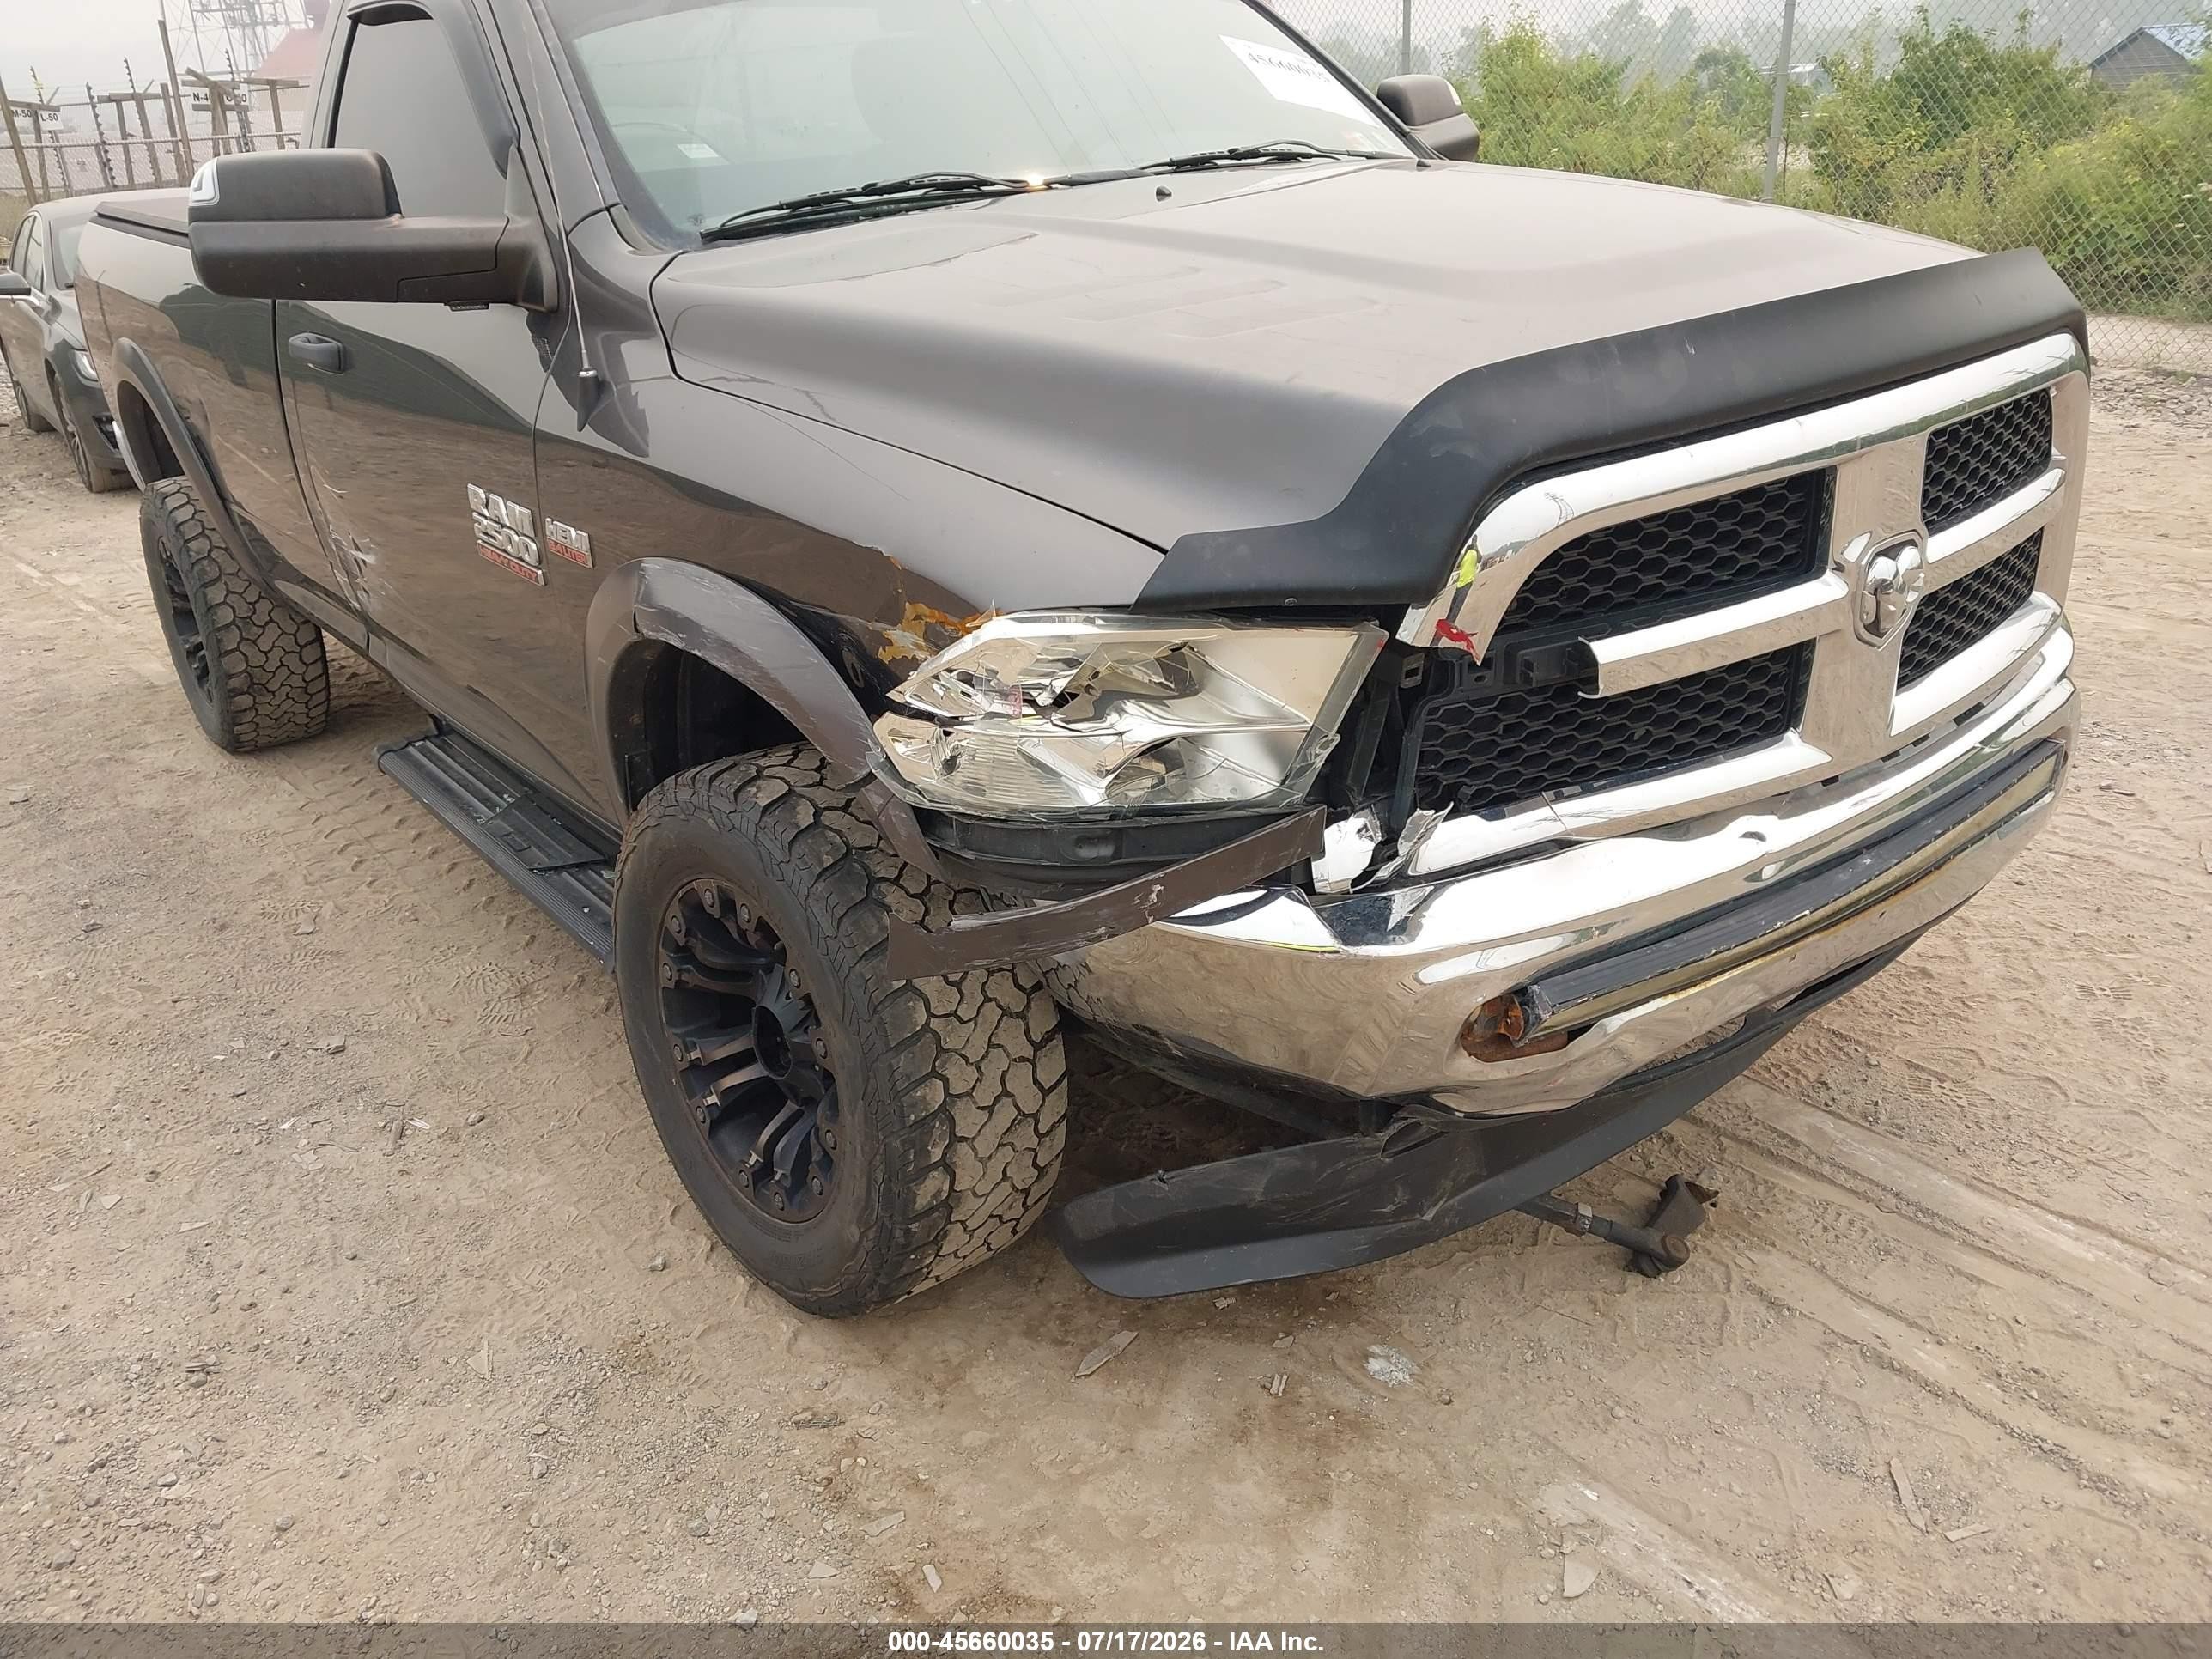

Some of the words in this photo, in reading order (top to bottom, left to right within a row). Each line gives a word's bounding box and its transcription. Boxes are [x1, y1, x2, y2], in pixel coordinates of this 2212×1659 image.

[192, 91, 212, 102] N-4
[40, 112, 59, 122] L-50
[466, 483, 537, 538] RAM
[472, 511, 541, 567] 2500
[544, 517, 591, 552] HEMI
